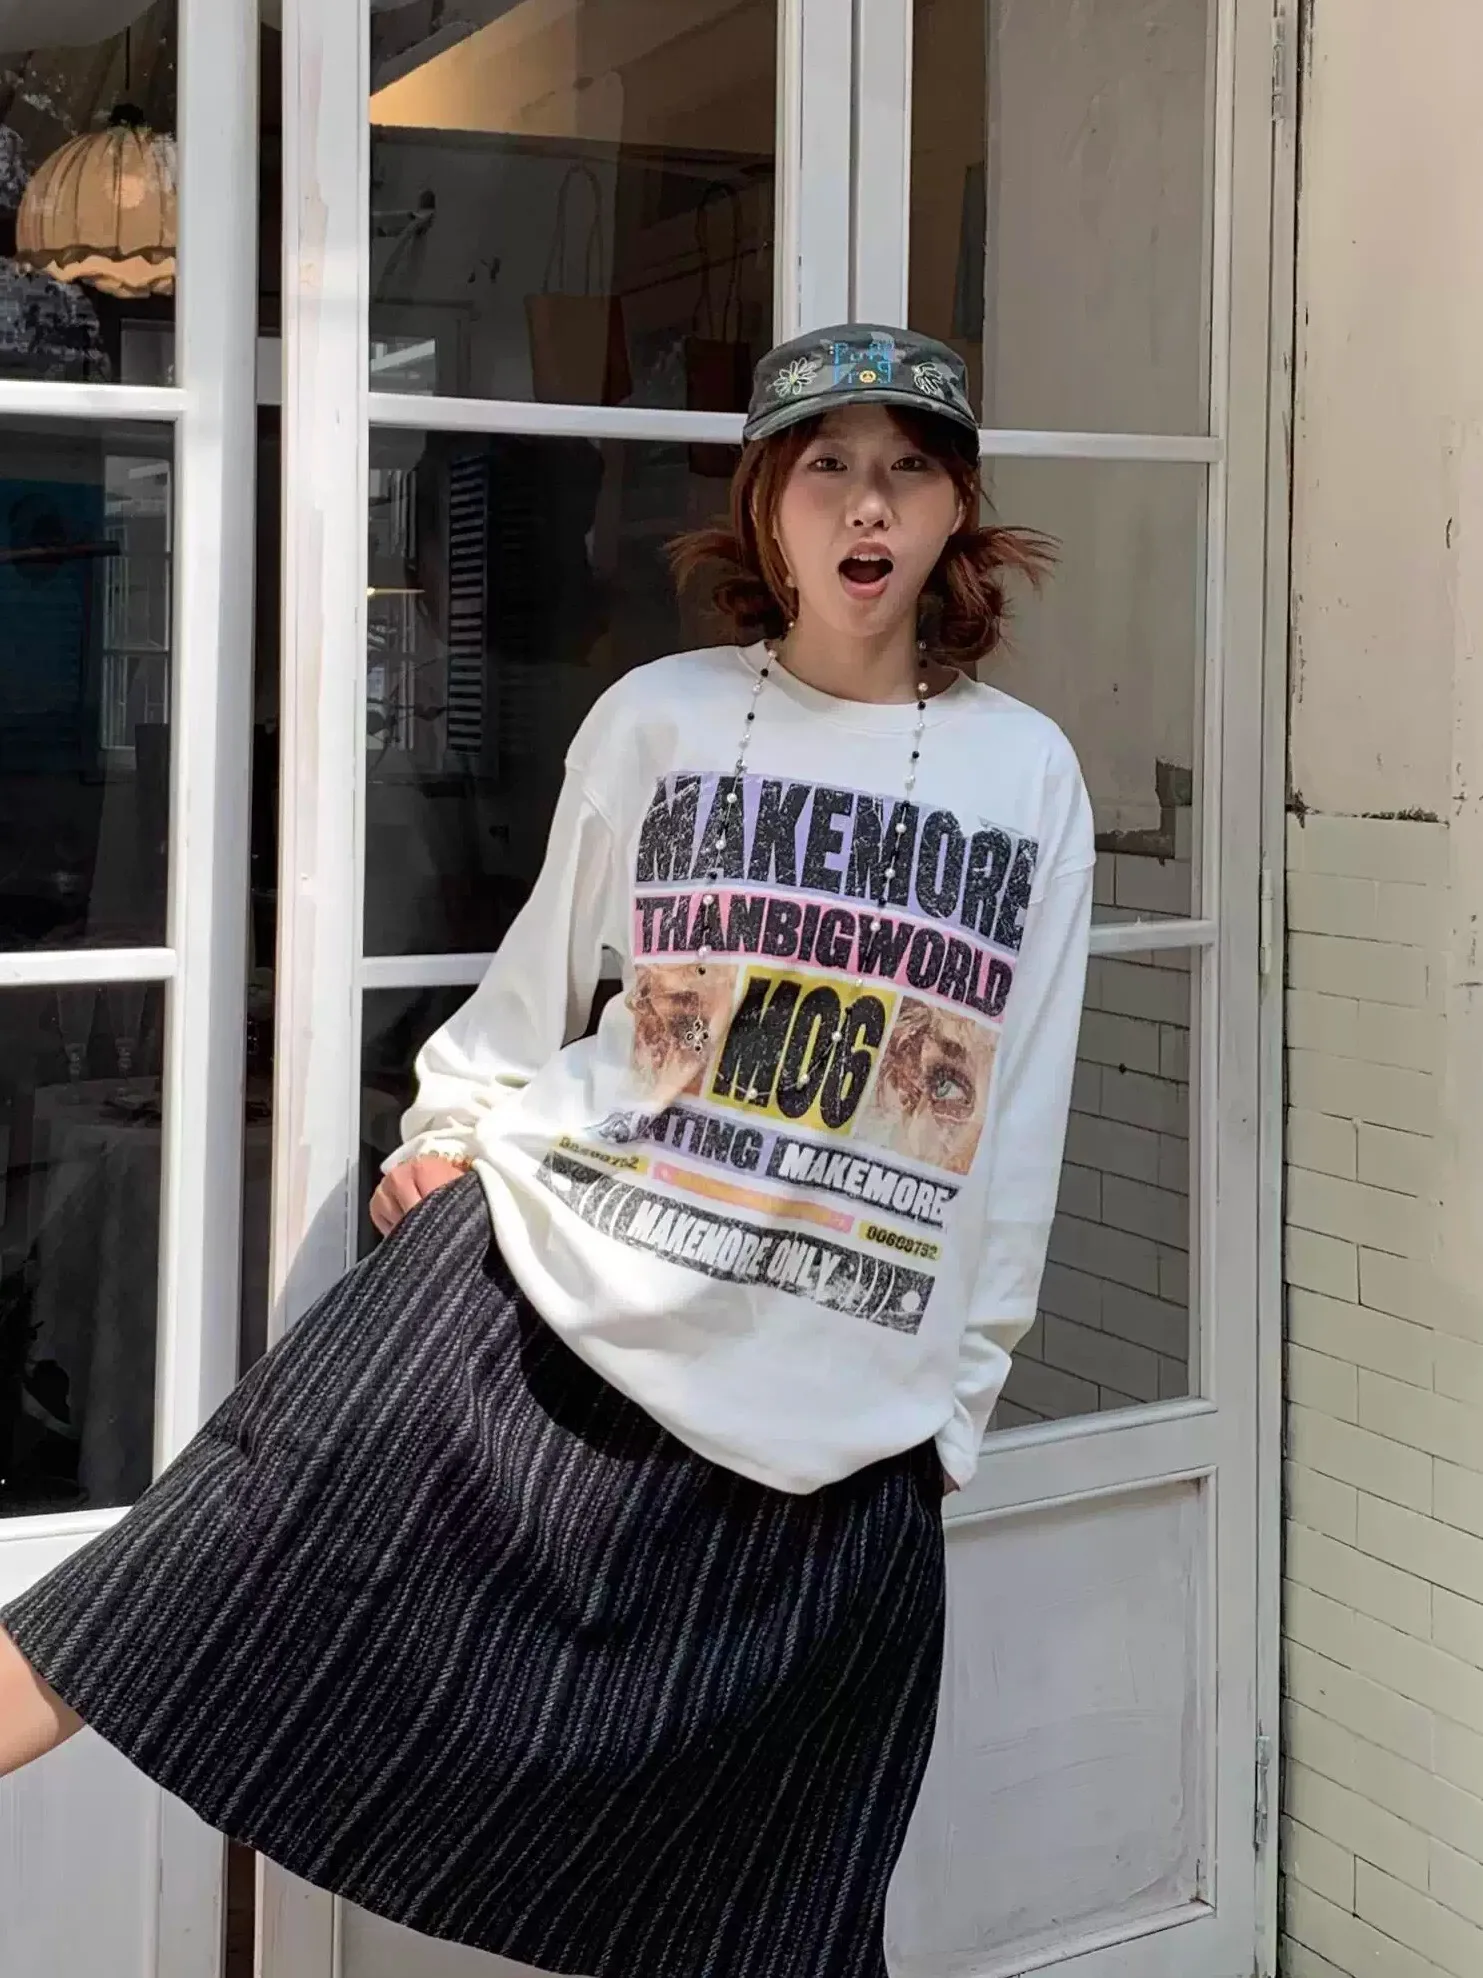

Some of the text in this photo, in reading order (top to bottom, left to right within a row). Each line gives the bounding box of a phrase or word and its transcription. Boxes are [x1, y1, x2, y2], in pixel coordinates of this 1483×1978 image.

[635, 774, 1039, 952] MAKEMORE
[635, 894, 1014, 1018] THANBIGWORLD
[778, 1143, 951, 1222] MAKEMORE
[627, 1200, 771, 1275] MAKEMORE
